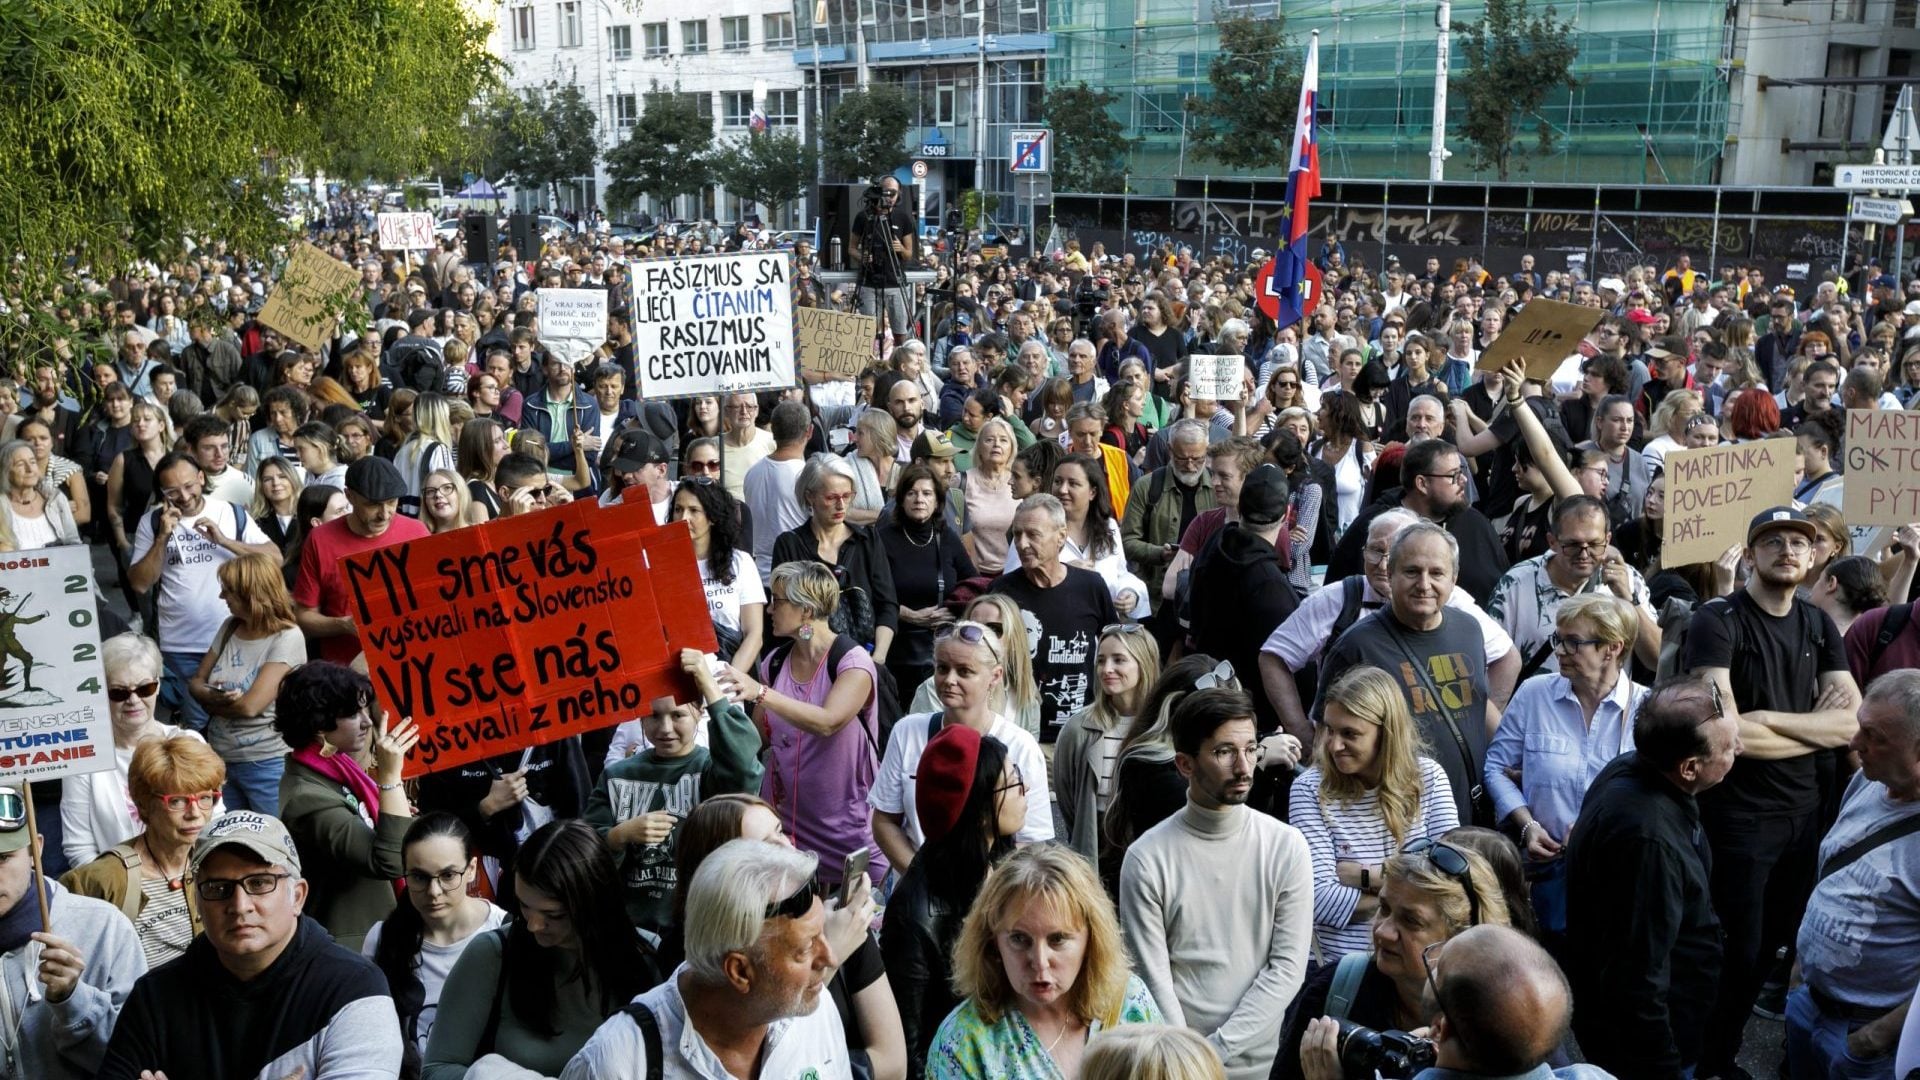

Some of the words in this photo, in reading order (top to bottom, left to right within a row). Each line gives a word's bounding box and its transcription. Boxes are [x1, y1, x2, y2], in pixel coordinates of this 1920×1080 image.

[923, 145, 945, 156] ČSOB
[756, 259, 784, 285] SA
[572, 320, 595, 328] KNIHY
[660, 316, 766, 350] RASIZMUS
[852, 336, 871, 355] NA
[817, 347, 873, 376] PROTESTY
[1673, 479, 1752, 514] POVEDZ
[345, 543, 419, 625] MY
[437, 545, 522, 601] sme
[527, 520, 597, 579] vás
[368, 604, 468, 660] vyštvali
[474, 602, 511, 630] na
[513, 568, 633, 623] Slovensko
[1048, 648, 1087, 664] Godfather
[1049, 636, 1065, 651] The
[377, 652, 435, 718] VY
[445, 653, 526, 706] ste
[533, 623, 621, 685] nás
[530, 707, 552, 732] z
[557, 679, 641, 726] neho
